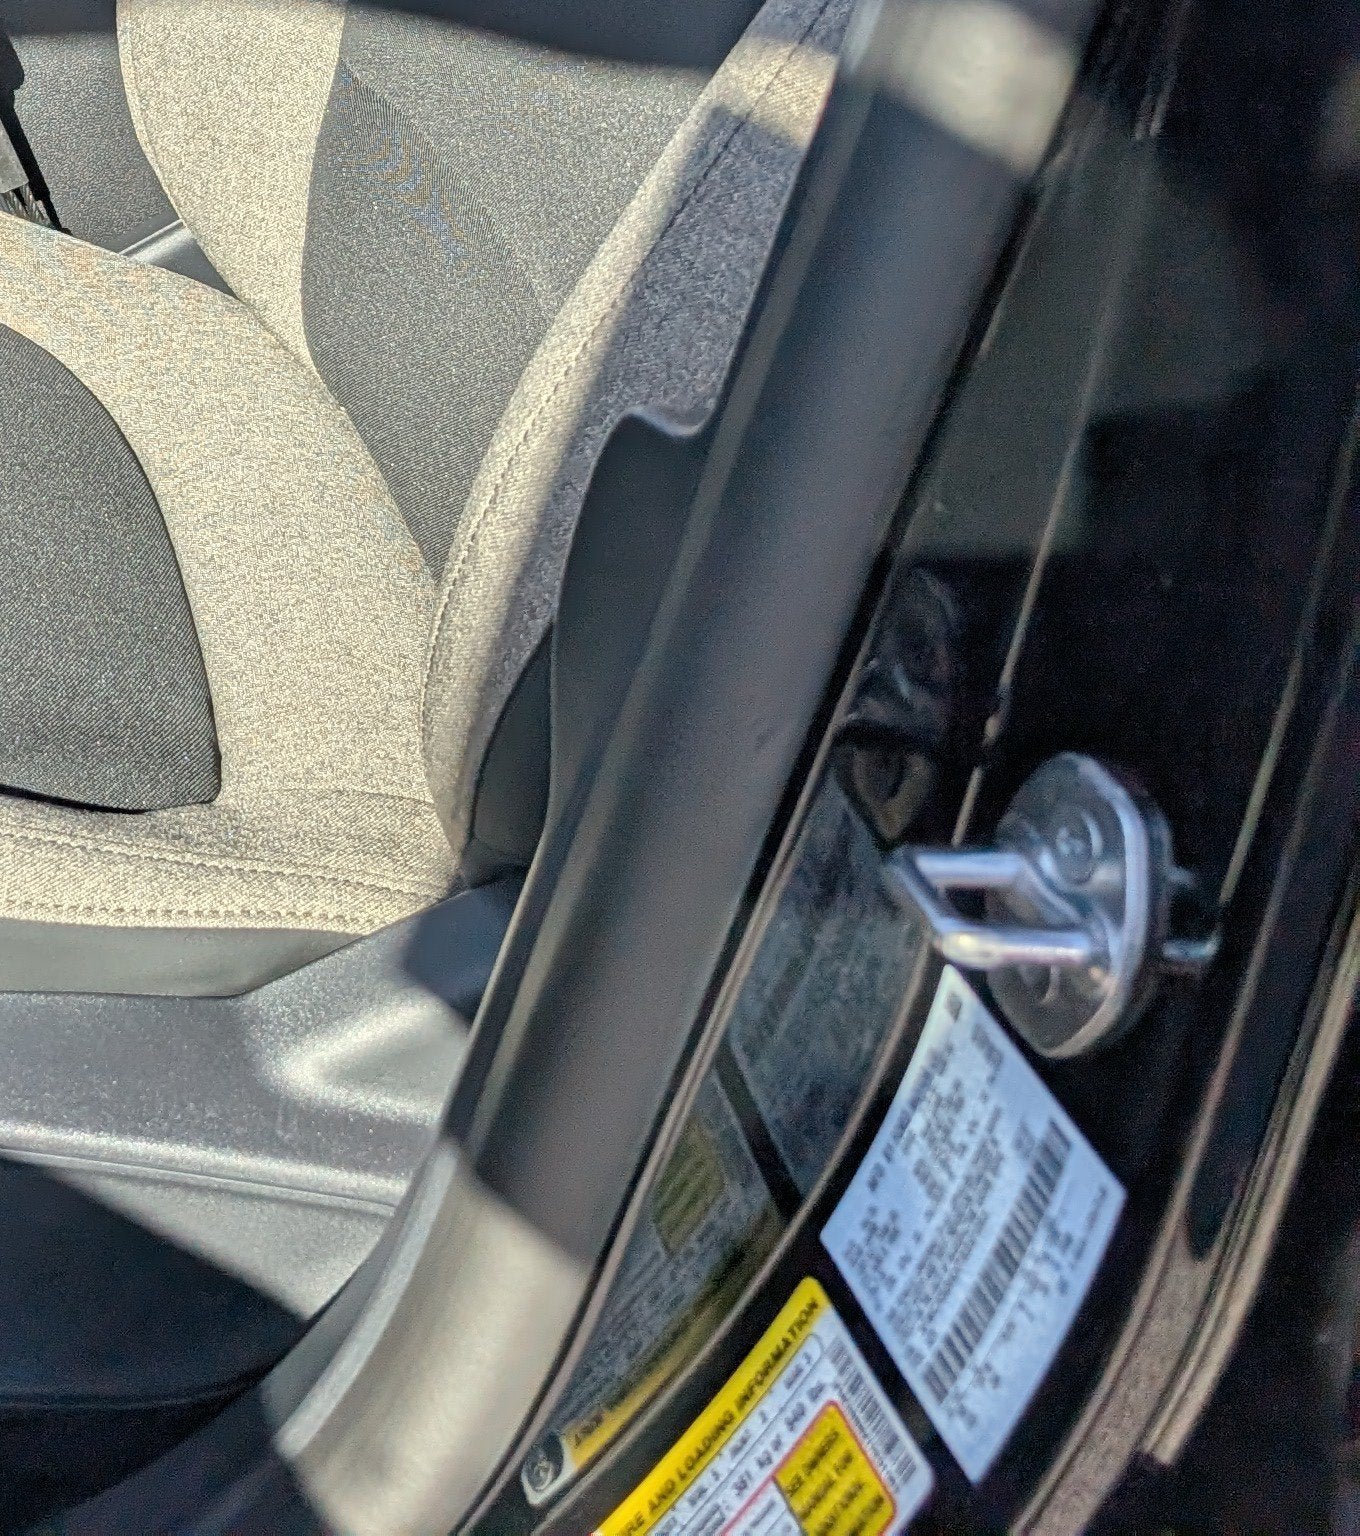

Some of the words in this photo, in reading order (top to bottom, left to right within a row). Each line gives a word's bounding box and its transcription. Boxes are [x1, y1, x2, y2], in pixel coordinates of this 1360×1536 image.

[647, 1477, 676, 1514] AND
[676, 1408, 736, 1482] LOADING
[734, 1297, 819, 1412] INFORMATION
